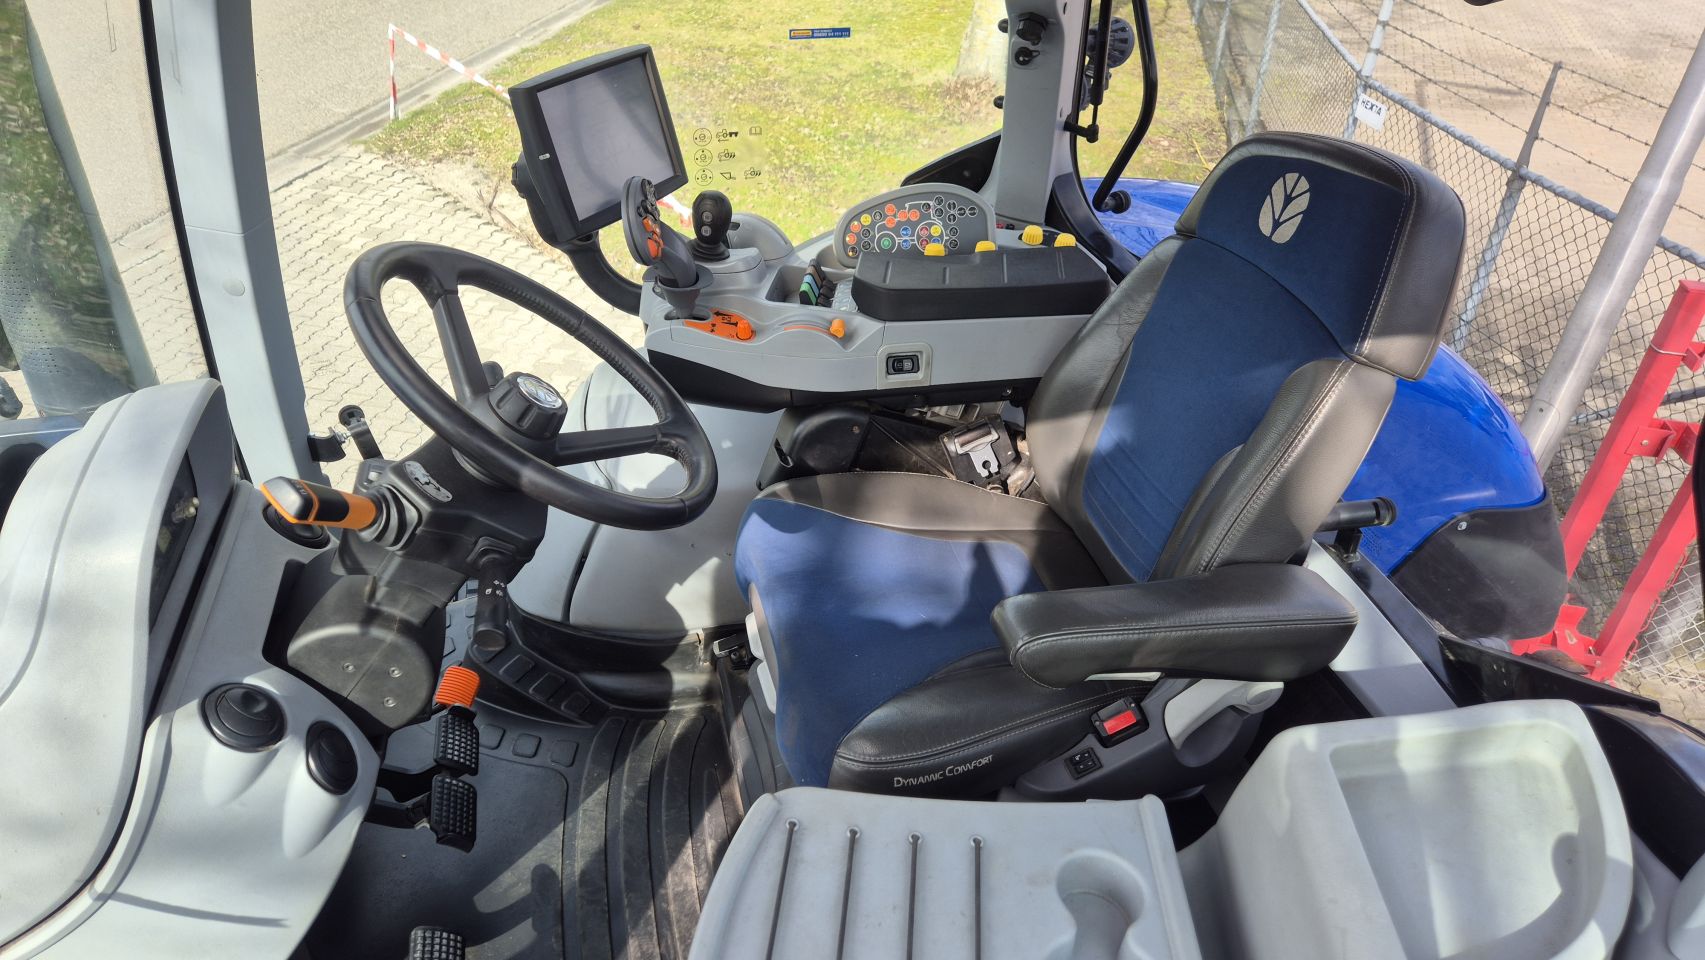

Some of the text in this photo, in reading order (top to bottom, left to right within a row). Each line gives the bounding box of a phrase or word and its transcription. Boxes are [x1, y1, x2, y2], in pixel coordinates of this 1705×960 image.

[1361, 98, 1382, 116] HEXTA
[893, 755, 993, 787] DYNAMIC COMFORT
